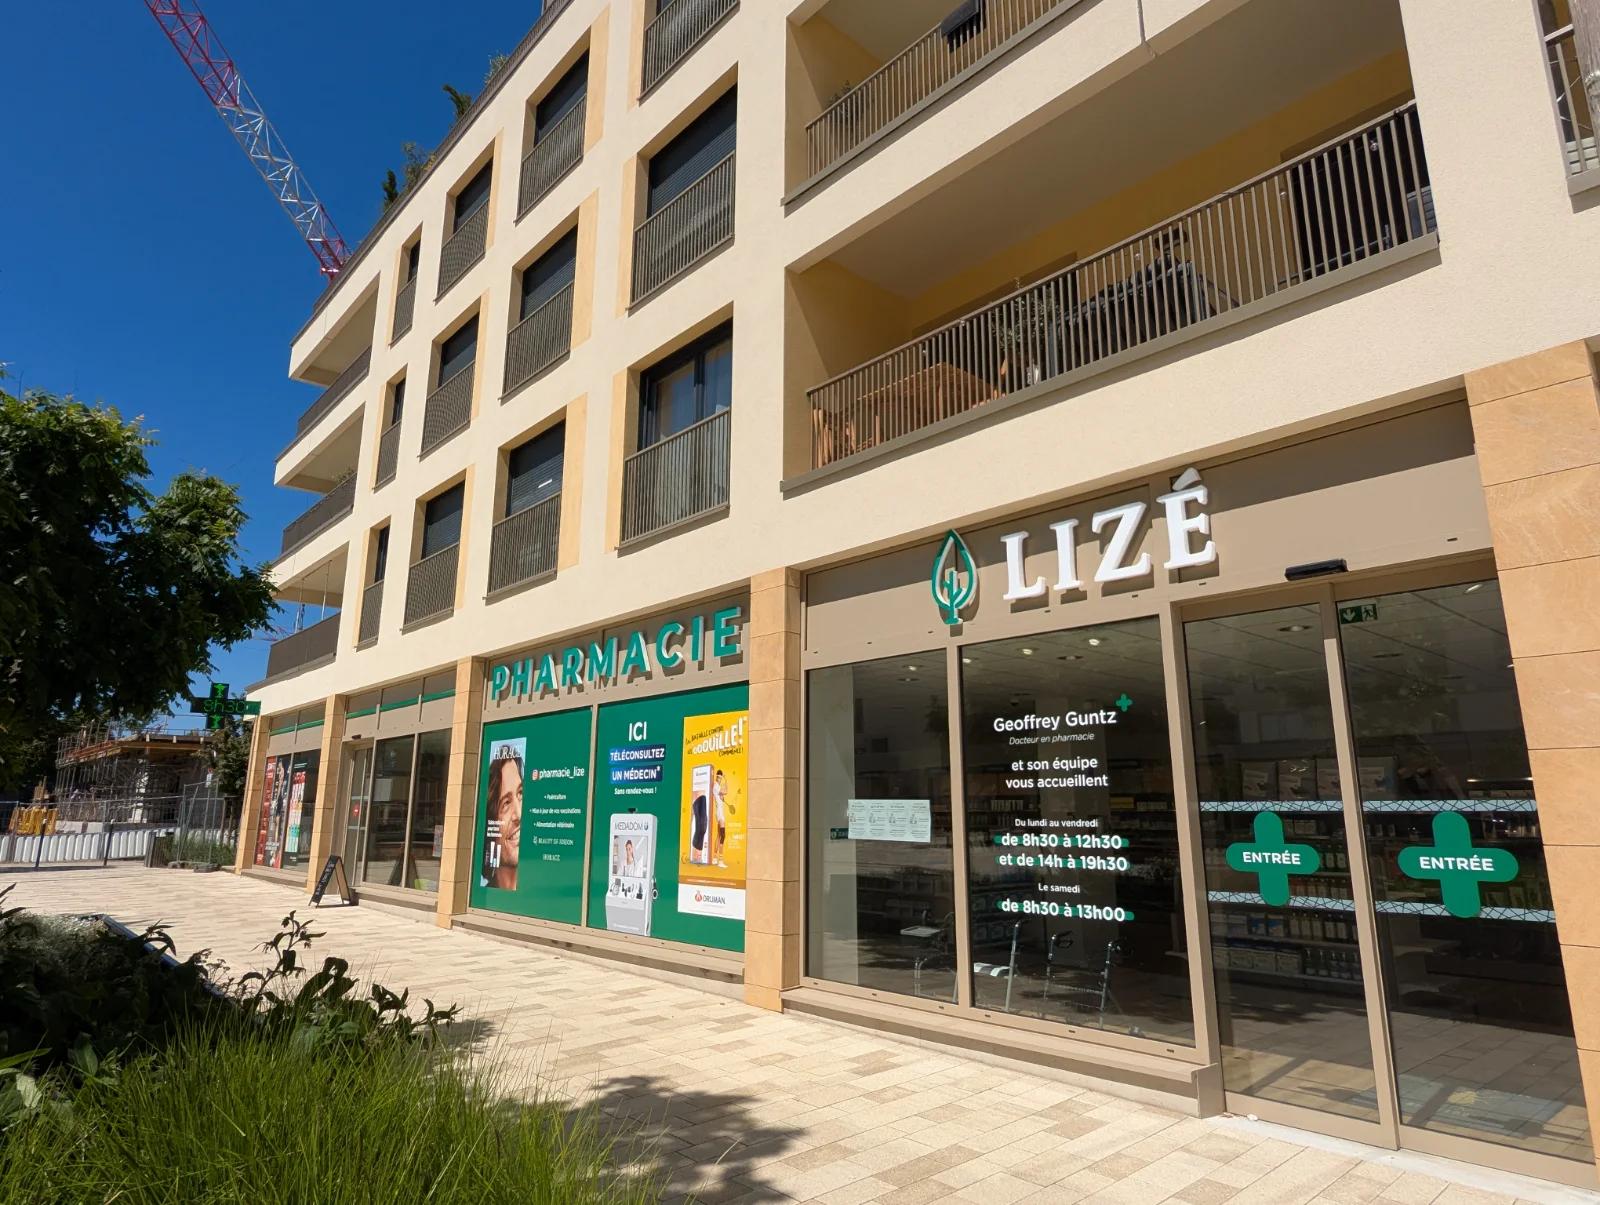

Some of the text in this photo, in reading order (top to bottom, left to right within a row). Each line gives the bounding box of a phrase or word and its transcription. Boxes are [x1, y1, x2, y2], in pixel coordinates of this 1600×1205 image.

[1001, 467, 1216, 600] LIZÉ
[491, 607, 742, 700] PHARMACIE
[993, 710, 1117, 731] Geoffrey Guntz
[629, 721, 647, 741] ICI
[1009, 735, 1039, 745] Docteur
[1052, 732, 1095, 744] pharmacie
[610, 747, 665, 761] TÉLÉCONSULTEZ
[1012, 755, 1098, 772] et son équipe
[612, 770, 623, 781] UN
[1006, 774, 1108, 788] vous accueillent
[1015, 818, 1098, 828] Du lundi au vendredi
[1001, 833, 1122, 849] de 8h30 à 12h30
[999, 853, 1127, 871] et de 14h à 19h30
[1243, 849, 1301, 865] ENTRÉE
[1419, 854, 1494, 872] ENTRÉE
[1038, 883, 1080, 894] Le samedi
[1001, 899, 1125, 922] de 8h30 à 13h00
